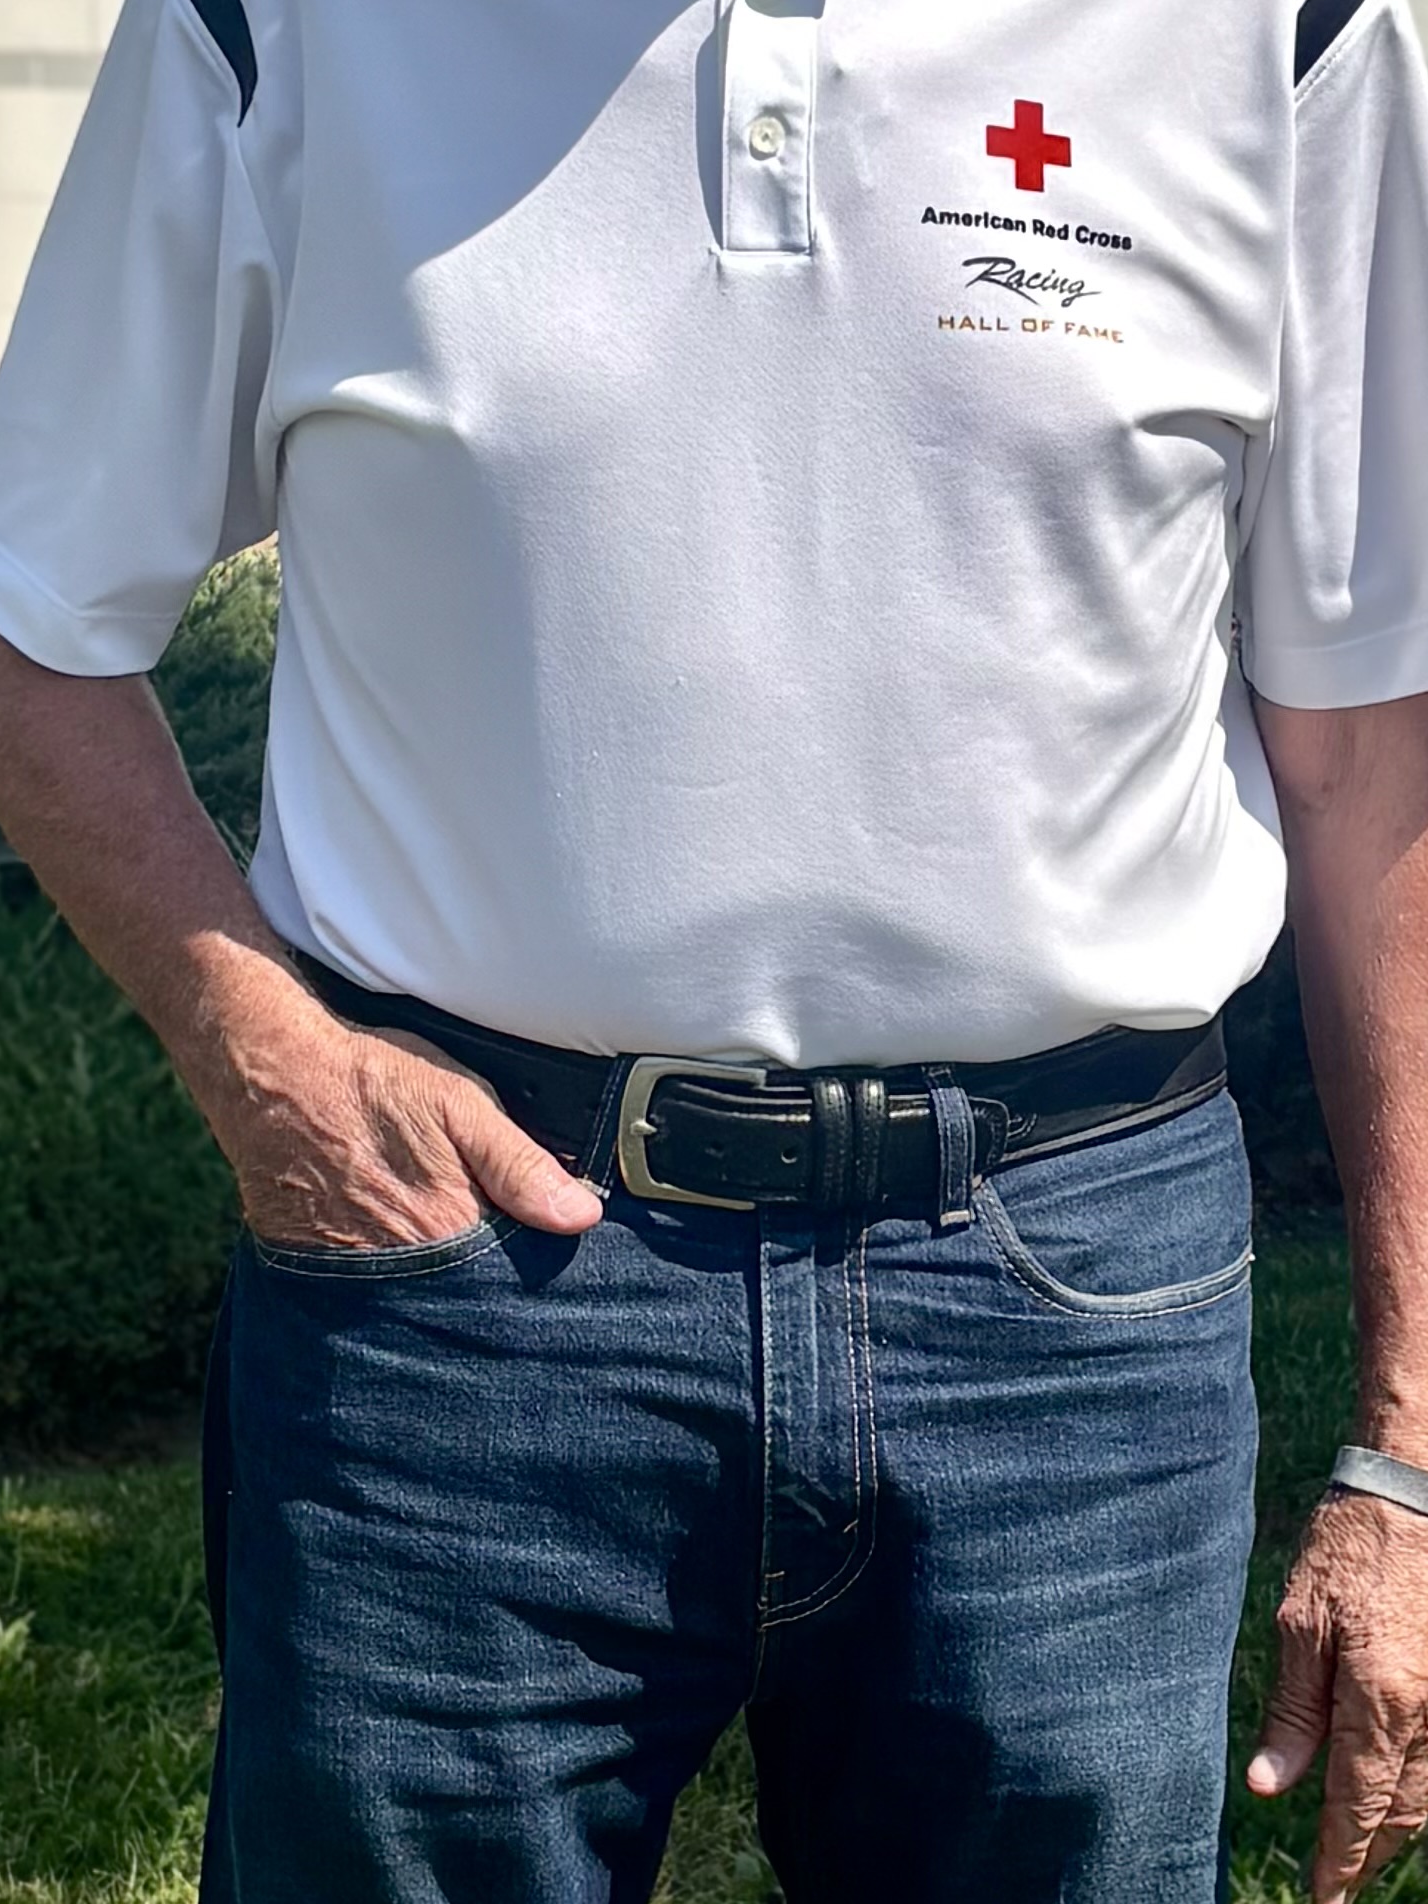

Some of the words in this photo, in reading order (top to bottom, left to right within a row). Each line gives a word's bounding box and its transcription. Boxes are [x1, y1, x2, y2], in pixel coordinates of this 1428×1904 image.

[921, 206, 1026, 233] American
[1032, 218, 1069, 241] Red
[1075, 225, 1132, 251] Cross
[962, 256, 1102, 307] Racing
[938, 314, 1010, 331] HALL
[1022, 318, 1054, 332] OF
[1065, 322, 1124, 343] FAME
